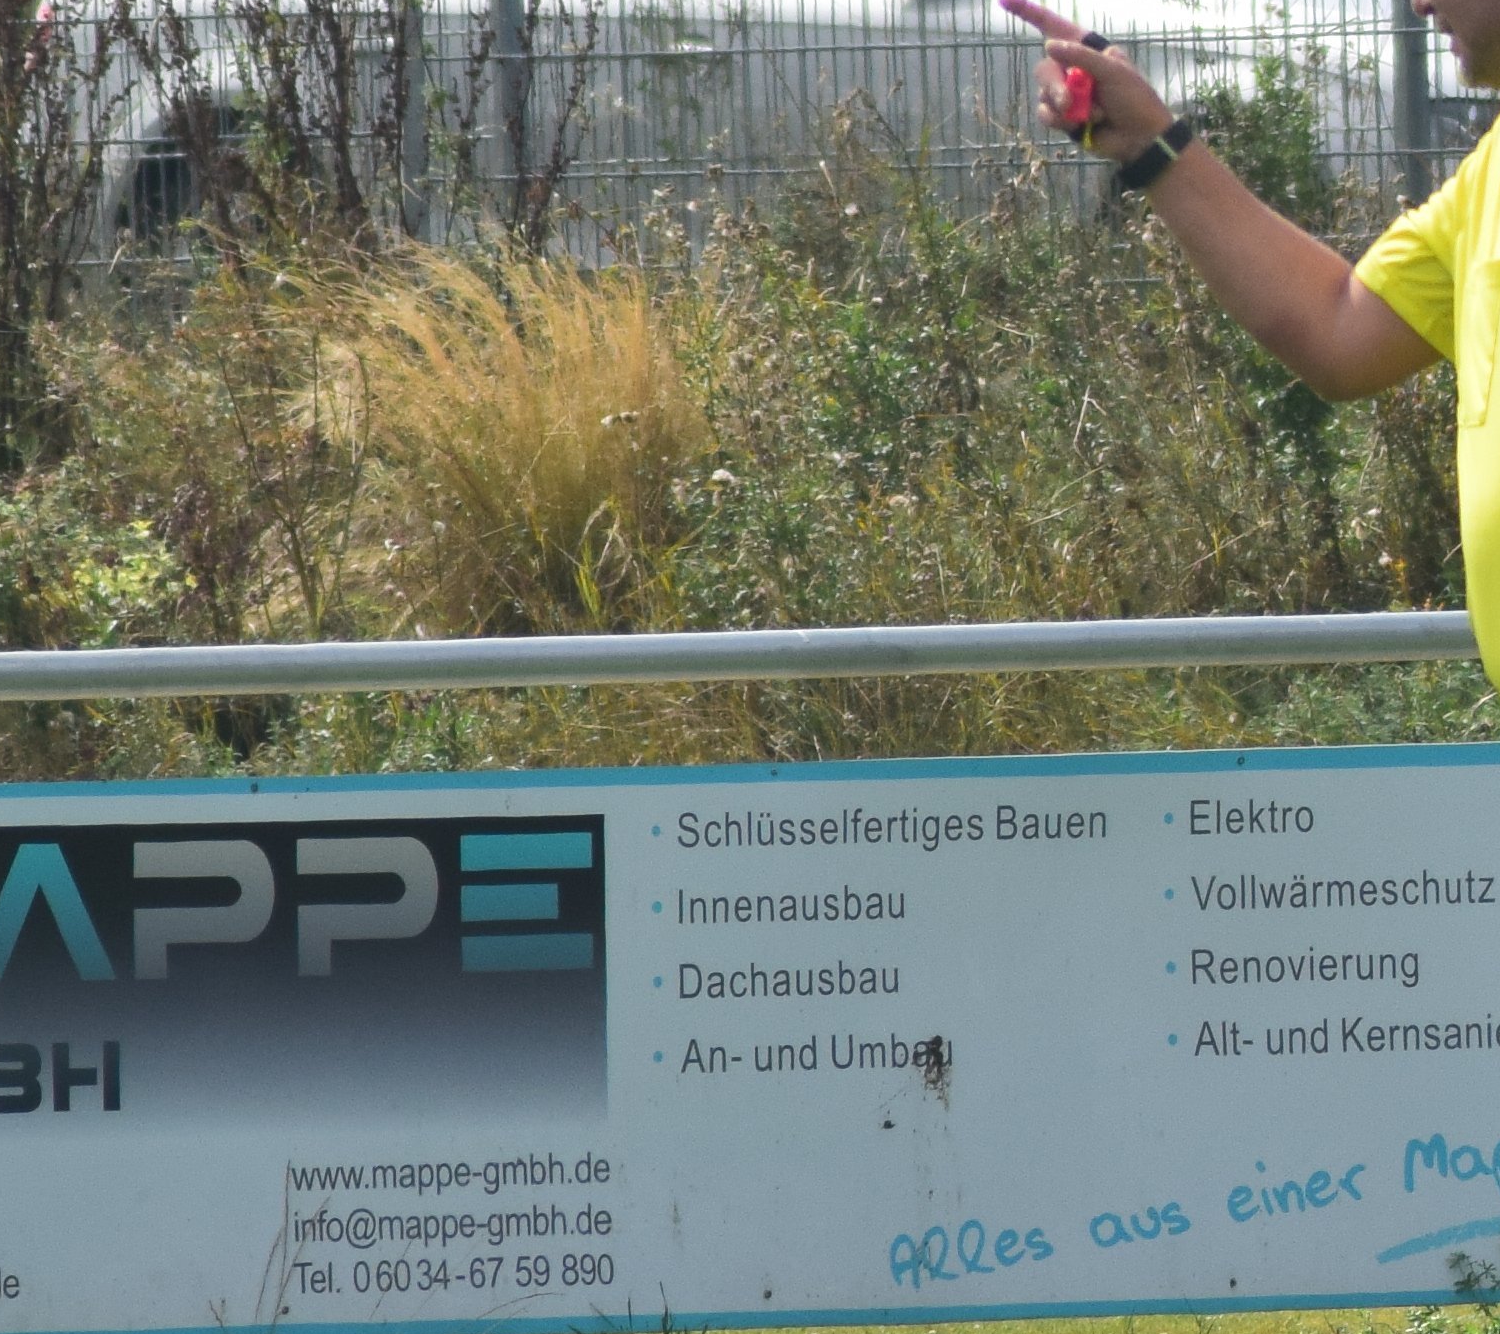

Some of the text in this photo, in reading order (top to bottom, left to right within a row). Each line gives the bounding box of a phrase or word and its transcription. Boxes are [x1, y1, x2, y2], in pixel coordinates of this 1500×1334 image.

[676, 804, 1108, 852] Schlüsselfertiges Bauen
[1189, 798, 1315, 835] Elektro
[677, 884, 907, 925] Innenausbau
[1191, 869, 1497, 911] Vollwärmeschutz
[678, 960, 901, 1000] Dachausbau
[1190, 947, 1421, 989] Renovierung
[681, 1032, 953, 1074] An- und Umbau
[1194, 1019, 1254, 1057] Alt-
[1265, 1017, 1330, 1055] und
[291, 1150, 611, 1196] www.mappe-gmbh.de
[293, 1201, 613, 1250] info@mappe-gmbh.de
[888, 1218, 1054, 1290] Alles
[1089, 1201, 1193, 1249] aus
[1226, 1160, 1367, 1223] einer
[293, 1261, 342, 1295] Tel.
[514, 1253, 551, 1288] 59
[560, 1252, 615, 1287] 890
